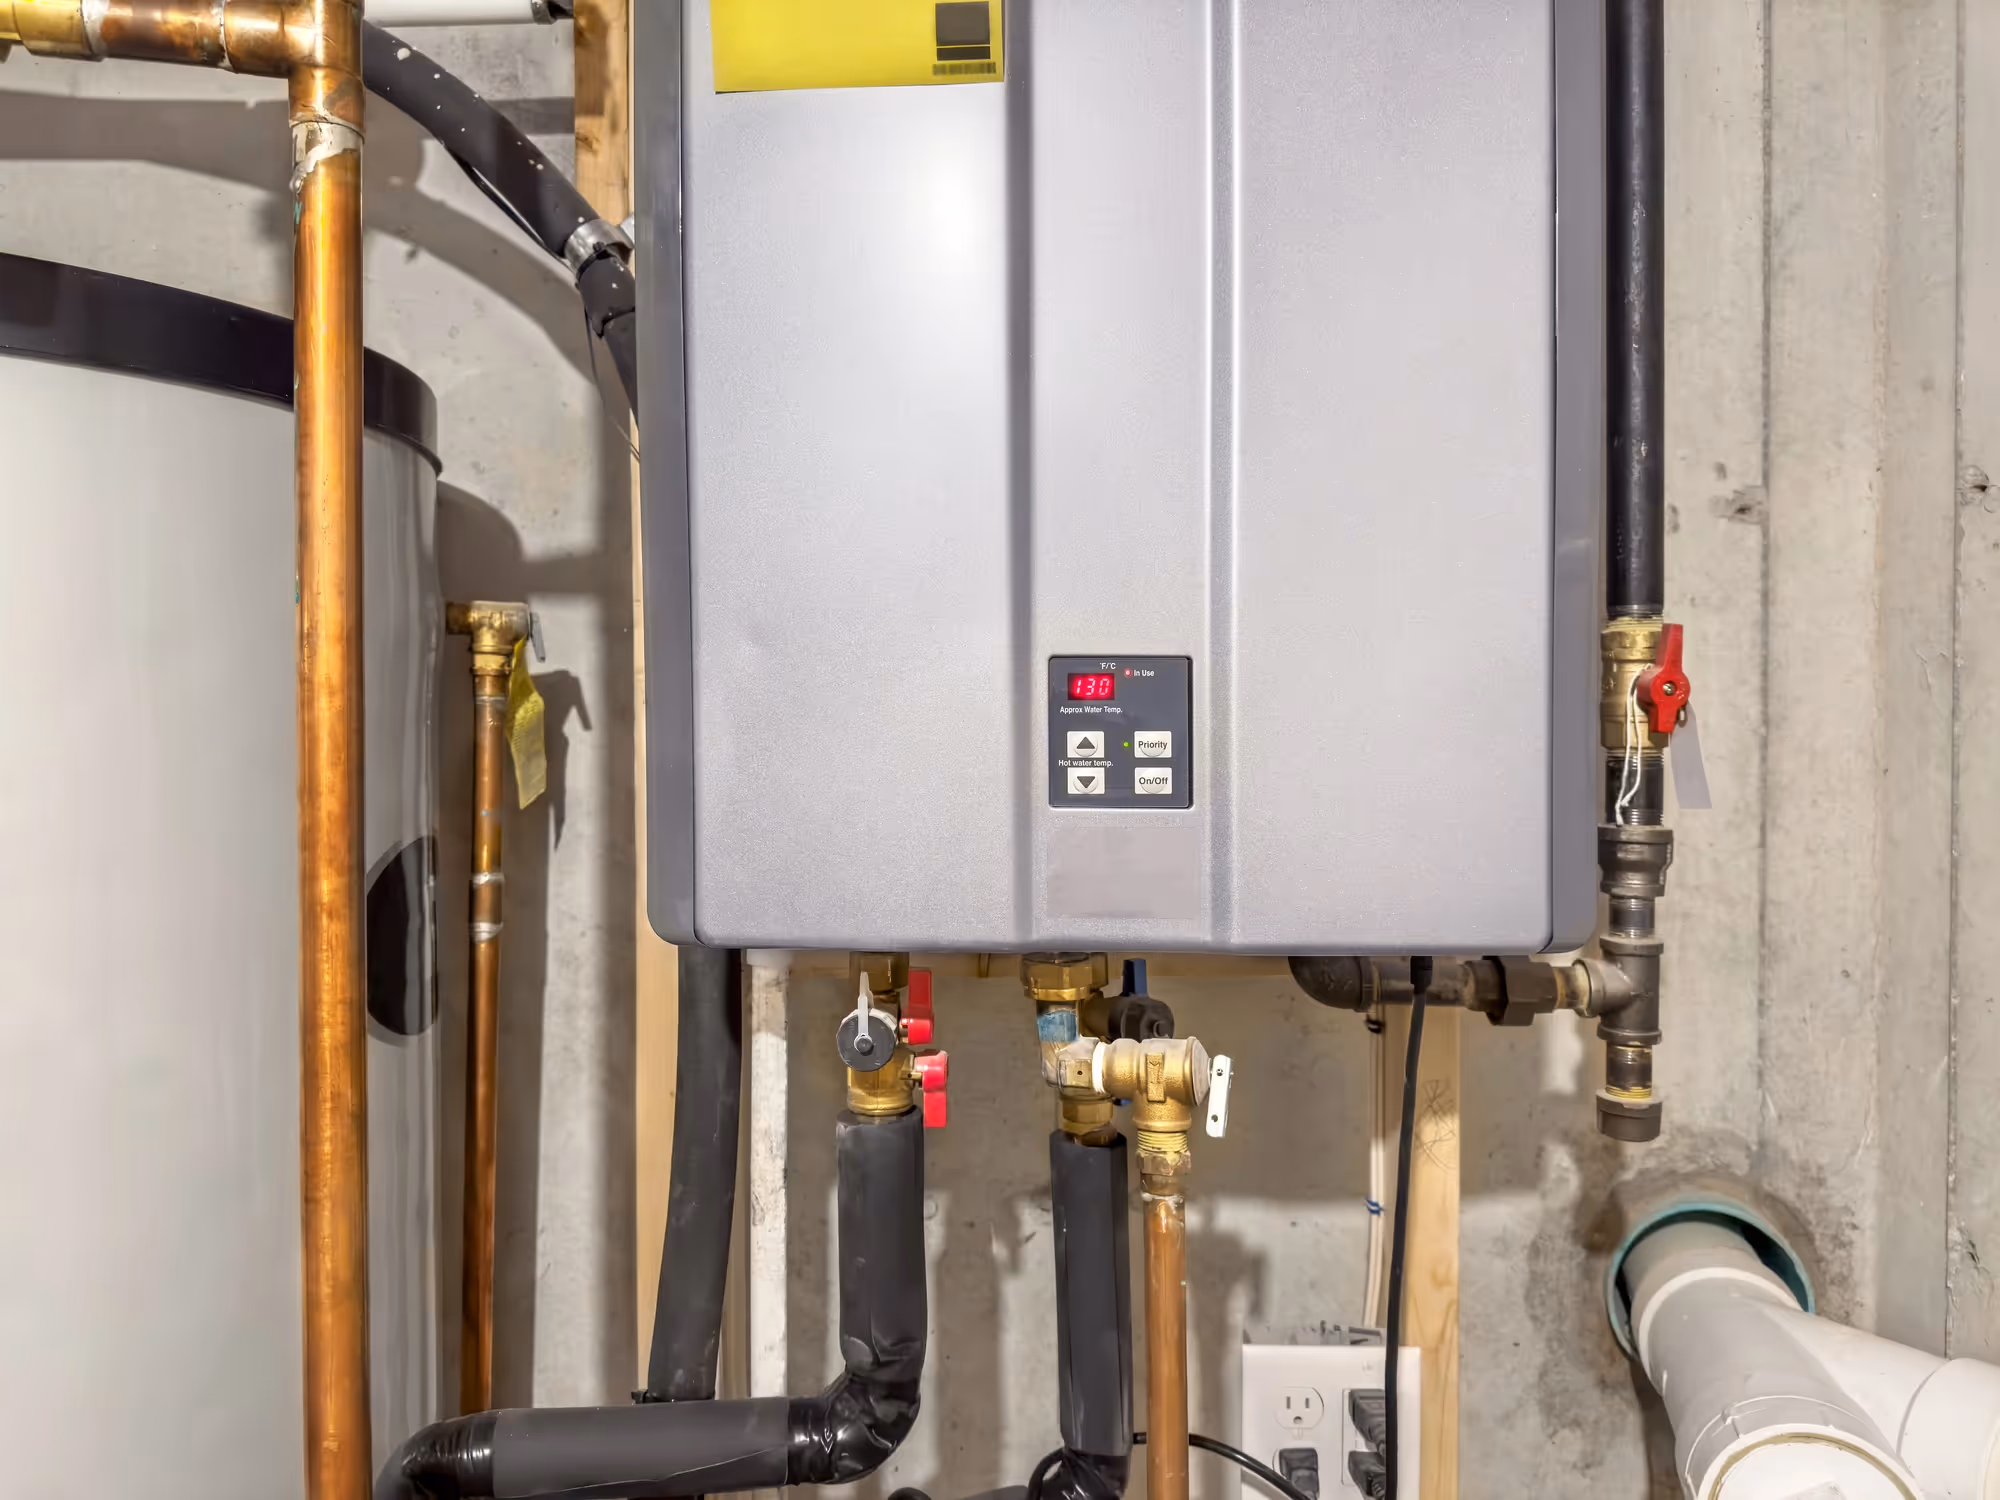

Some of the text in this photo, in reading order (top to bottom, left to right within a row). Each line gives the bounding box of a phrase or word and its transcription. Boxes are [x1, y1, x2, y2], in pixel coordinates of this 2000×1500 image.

[1133, 669, 1155, 677] In Use
[1075, 677, 1110, 696] 130
[1059, 706, 1083, 714] Approx
[1103, 706, 1123, 714] Temp.
[1138, 740, 1168, 750] Priority
[1058, 759, 1114, 768] Hot water temp.
[1138, 776, 1169, 785] On/Off
